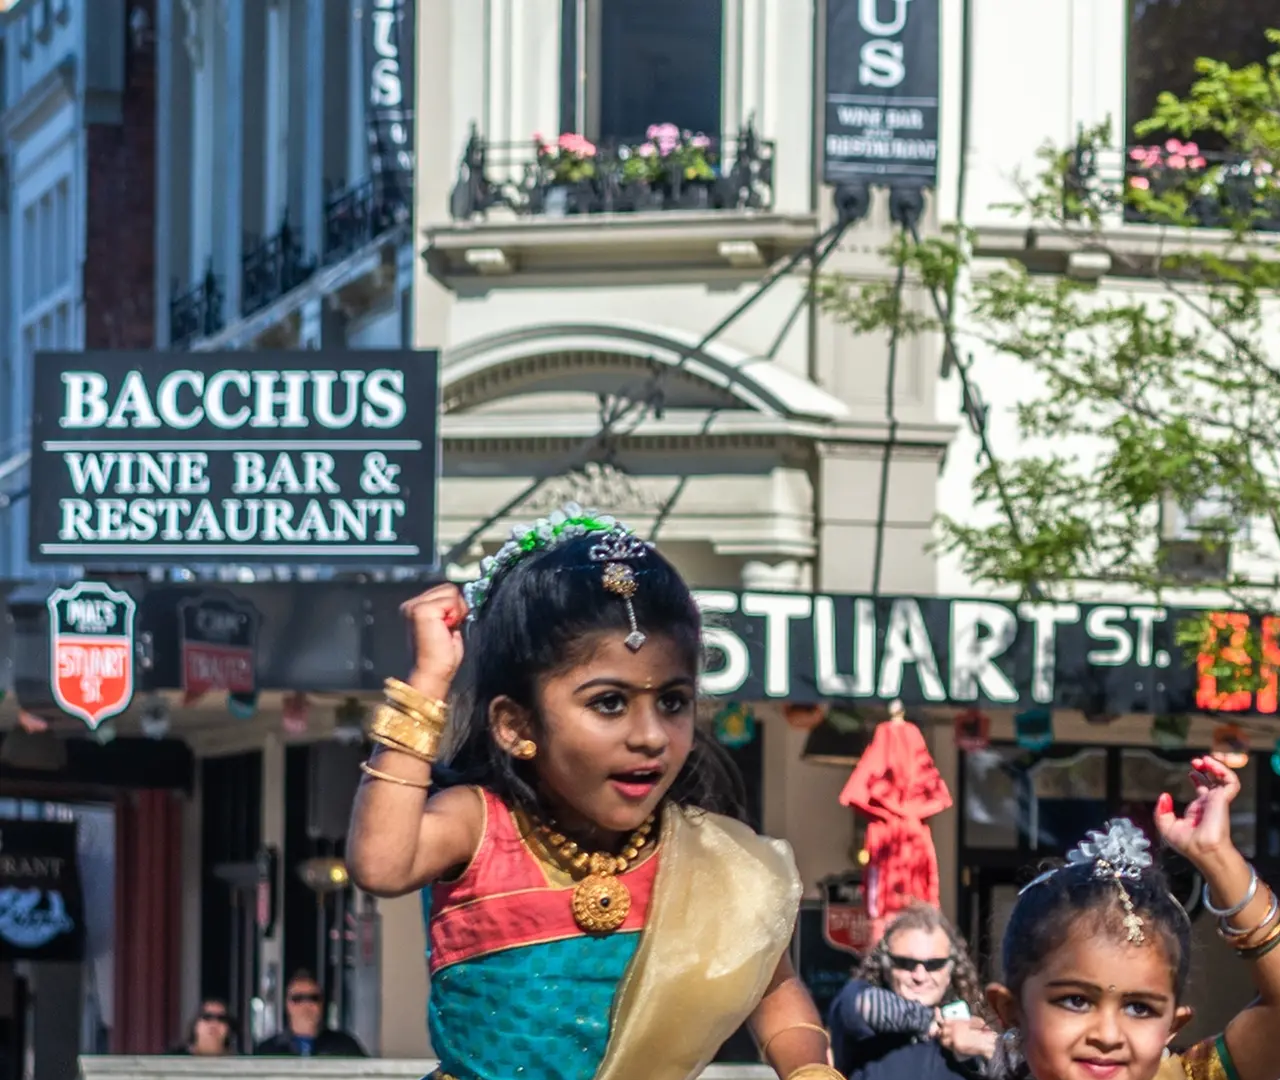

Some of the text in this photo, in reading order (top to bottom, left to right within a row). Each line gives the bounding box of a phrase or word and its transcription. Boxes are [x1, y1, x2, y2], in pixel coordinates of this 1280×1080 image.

[58, 370, 407, 430] BACCHUS
[64, 451, 402, 495] WINE BAR &
[58, 498, 406, 542] RESTAURANT
[57, 645, 130, 679] STUART
[695, 590, 1172, 703] STUART ST.
